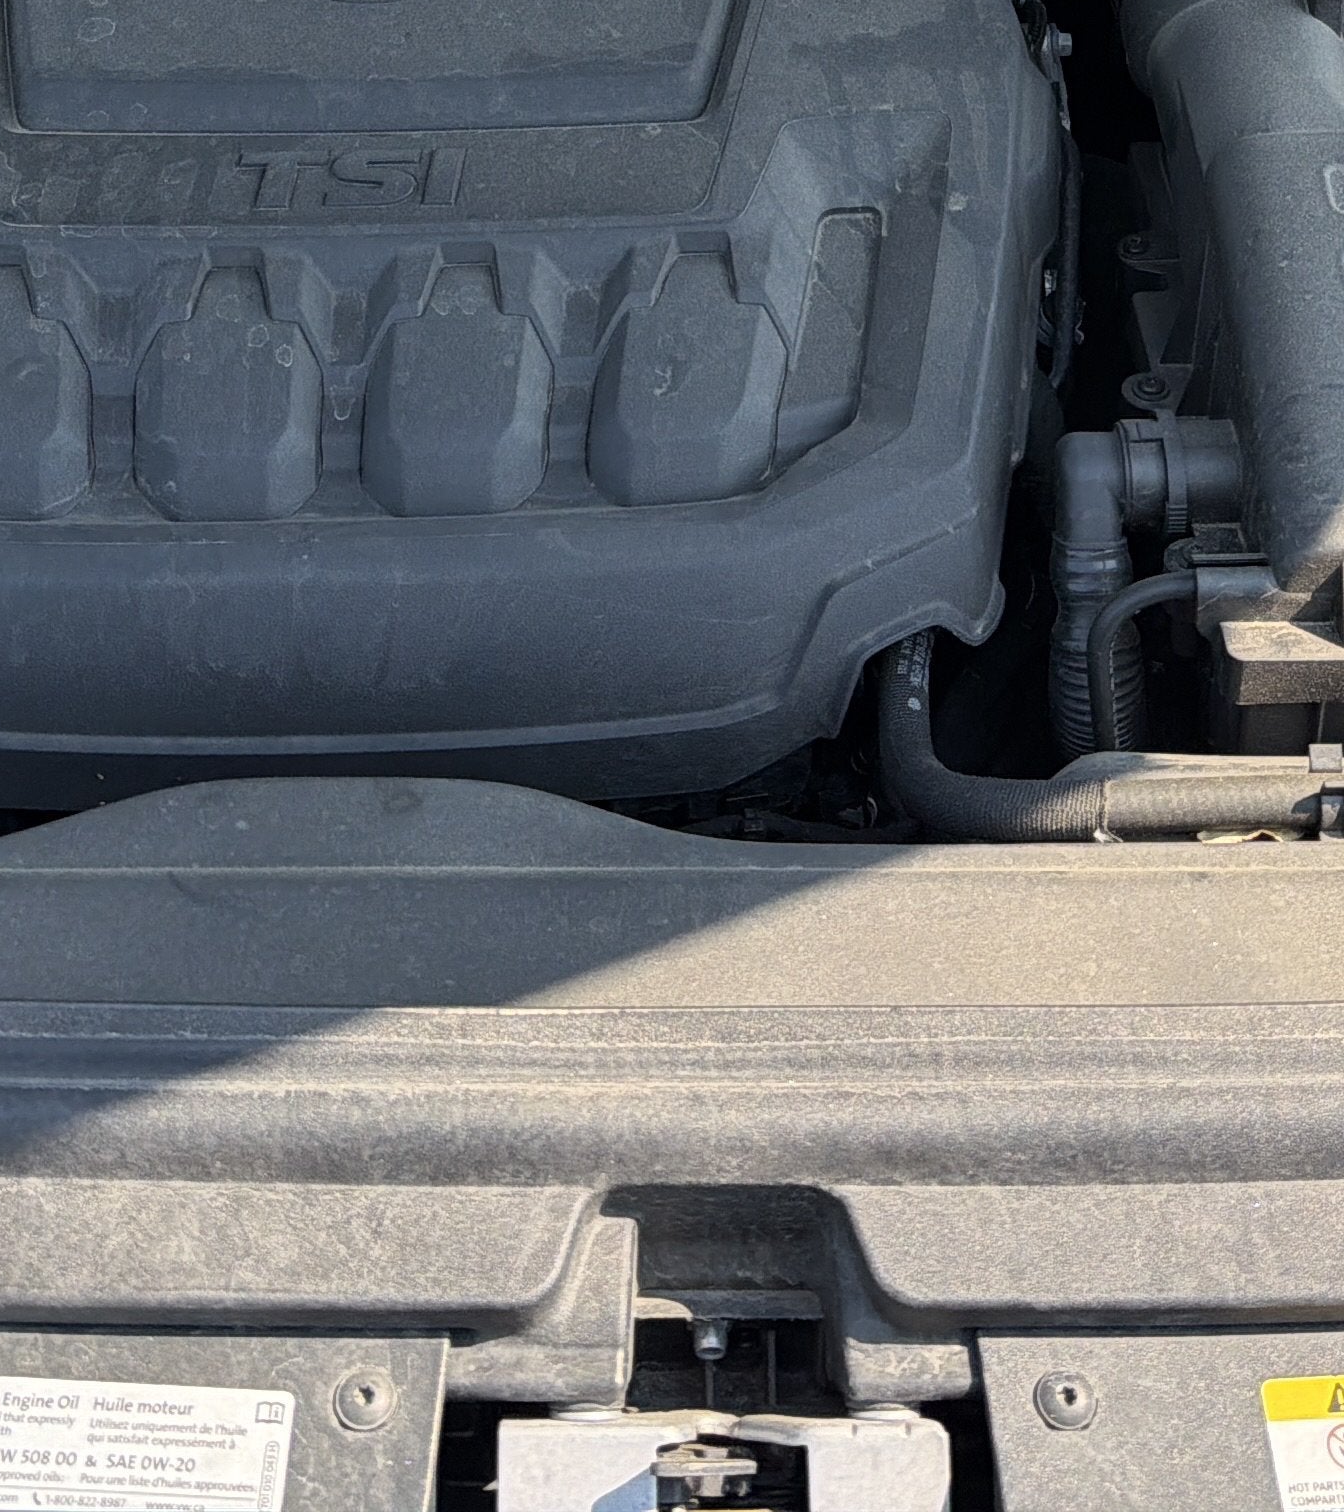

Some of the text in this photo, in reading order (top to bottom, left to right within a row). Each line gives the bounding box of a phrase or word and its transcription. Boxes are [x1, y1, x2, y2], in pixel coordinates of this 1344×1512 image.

[234, 148, 468, 211] TSI
[2, 1391, 194, 1416] Engine Oil Huile moteur
[3, 1412, 24, 1423] that
[27, 1415, 76, 1427] expressly
[131, 1422, 198, 1435] uniquement
[199, 1423, 213, 1434] de
[87, 1434, 105, 1445] qui
[20, 1449, 51, 1465] 508
[54, 1451, 78, 1466] 00
[84, 1455, 97, 1467] &
[106, 1453, 137, 1470] SAE
[140, 1455, 196, 1473] 0W-20
[79, 1472, 104, 1485] Pour
[105, 1474, 127, 1485] une
[128, 1474, 150, 1486] liste
[151, 1476, 192, 1489] d'huiles
[1288, 1482, 1316, 1494] HOT
